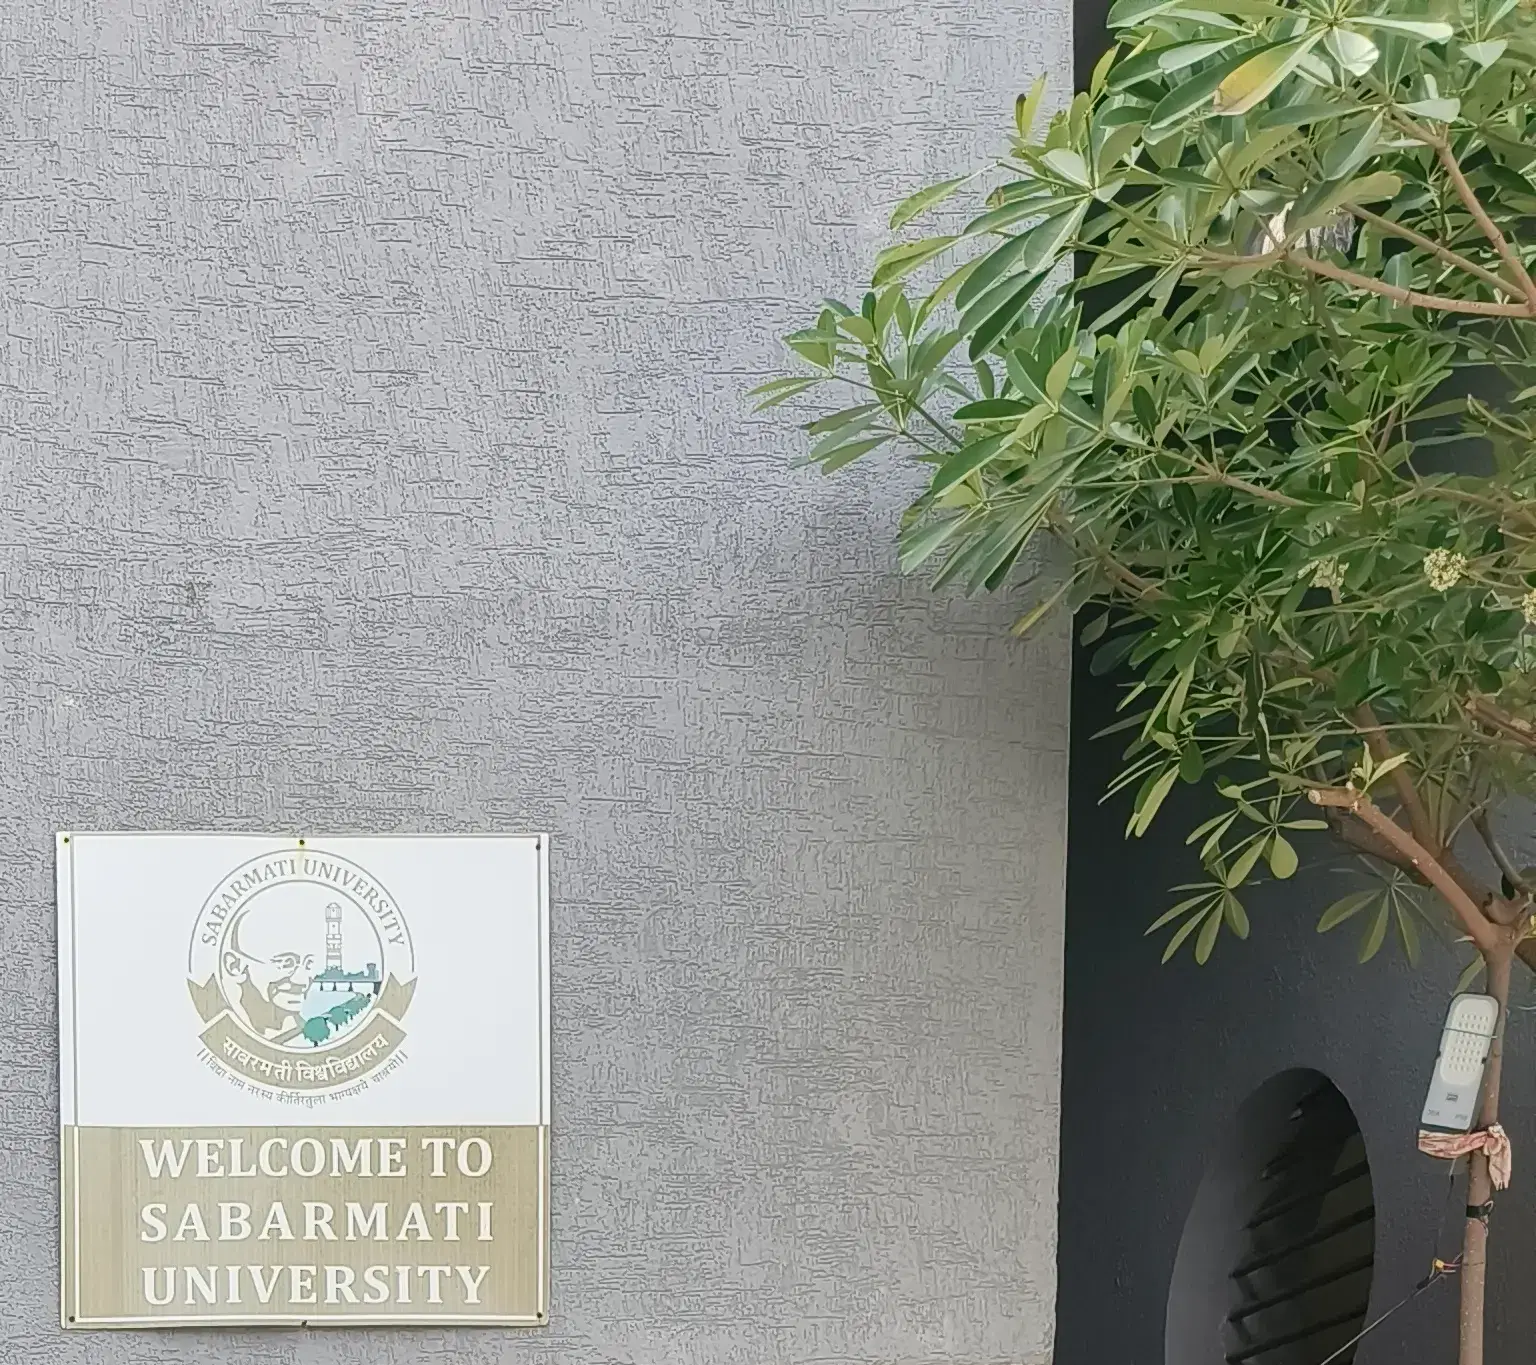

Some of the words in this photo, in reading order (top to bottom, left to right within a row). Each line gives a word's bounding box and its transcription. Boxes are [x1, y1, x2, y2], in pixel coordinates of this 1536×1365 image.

[201, 858, 297, 947] SABARMATI
[303, 858, 405, 946] UNIVERSITY
[138, 1137, 407, 1178] WELCOME
[421, 1137, 494, 1177] TO
[140, 1201, 494, 1242] SABARMATI
[141, 1264, 491, 1305] UNIVERSITY
